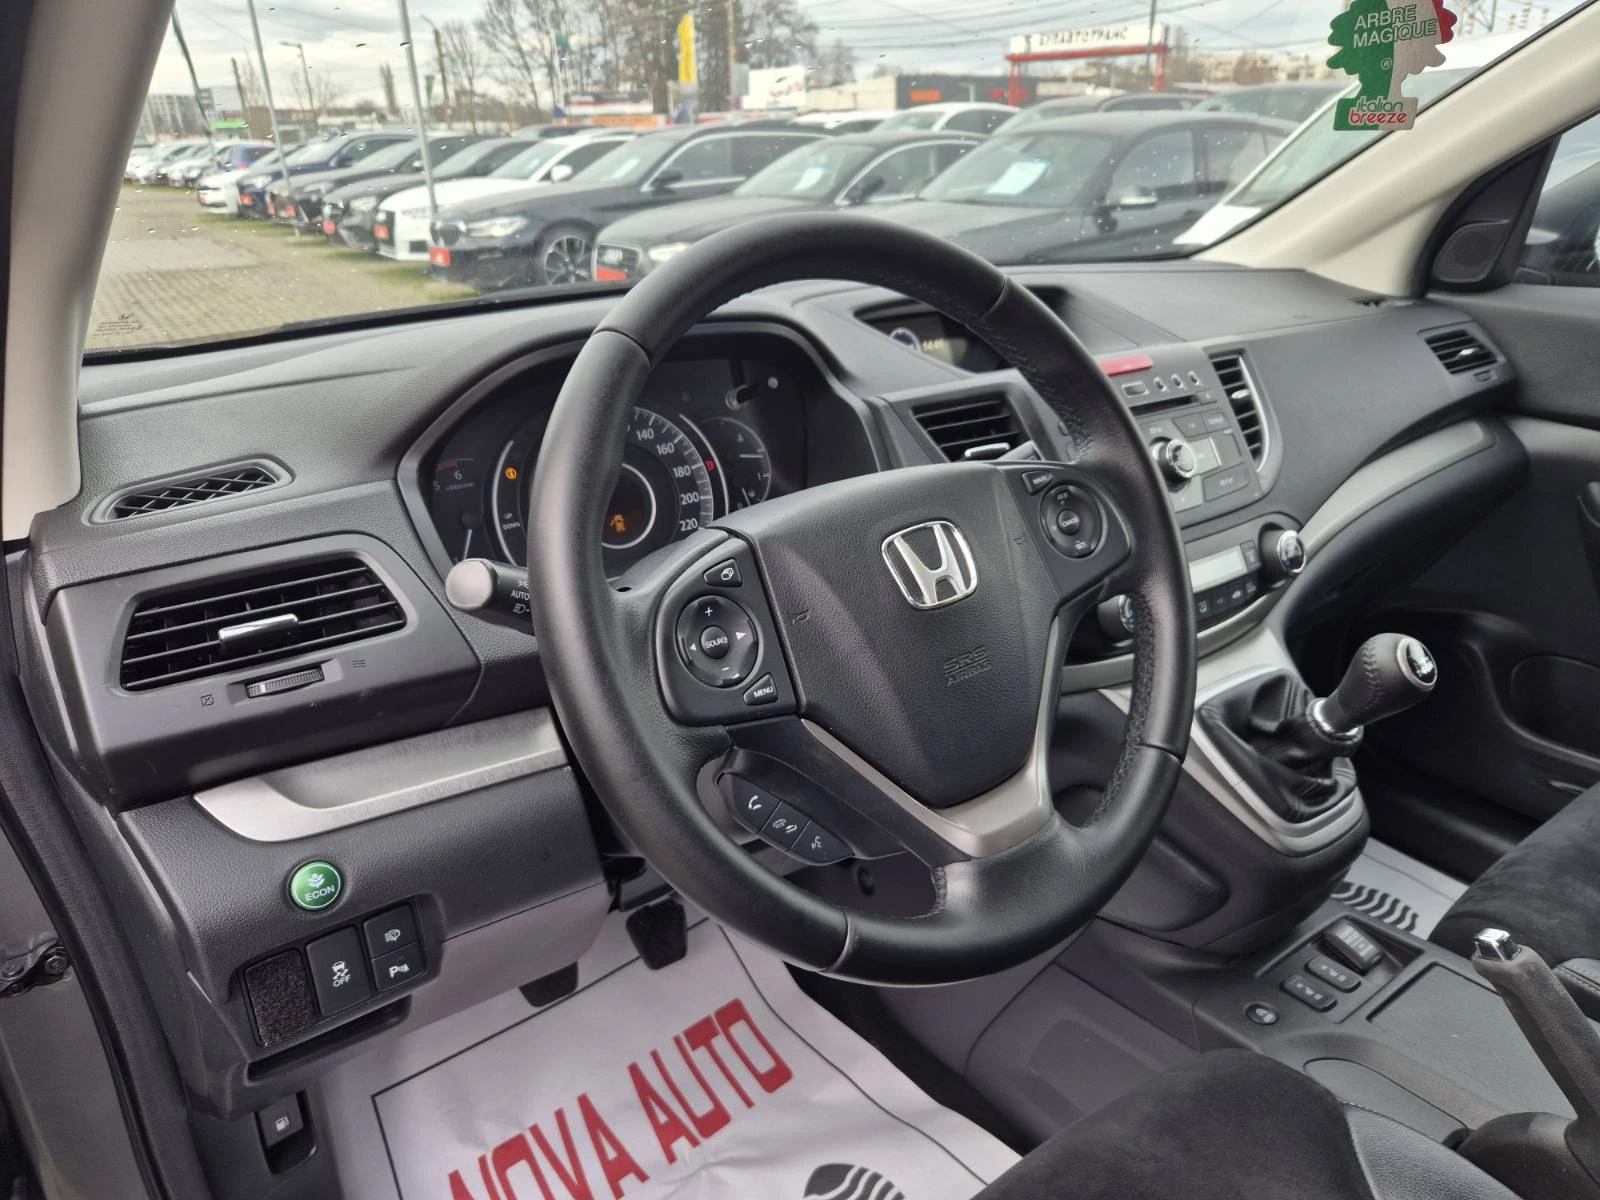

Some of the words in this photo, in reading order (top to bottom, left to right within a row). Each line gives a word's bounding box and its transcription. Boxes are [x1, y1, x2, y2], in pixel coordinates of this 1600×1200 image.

[1354, 4, 1417, 31] ARBRE
[1353, 18, 1437, 49] MAGIQUE
[1356, 96, 1403, 112] italian
[1349, 109, 1407, 125] breeze
[636, 428, 655, 441] 140
[656, 443, 675, 456] 160
[454, 470, 463, 480] 6
[673, 466, 691, 478] 180
[432, 481, 440, 491] 5
[680, 492, 699, 505] 200
[504, 512, 513, 520] UP
[503, 521, 521, 530] DOWN
[680, 518, 698, 531] 220
[511, 589, 530, 601] AUTO
[705, 636, 728, 649] SOURCE
[943, 646, 988, 674] SRS
[753, 686, 774, 698] MENU
[305, 885, 336, 902] ECON
[332, 974, 352, 988] OFF
[628, 997, 794, 1165] AUTO
